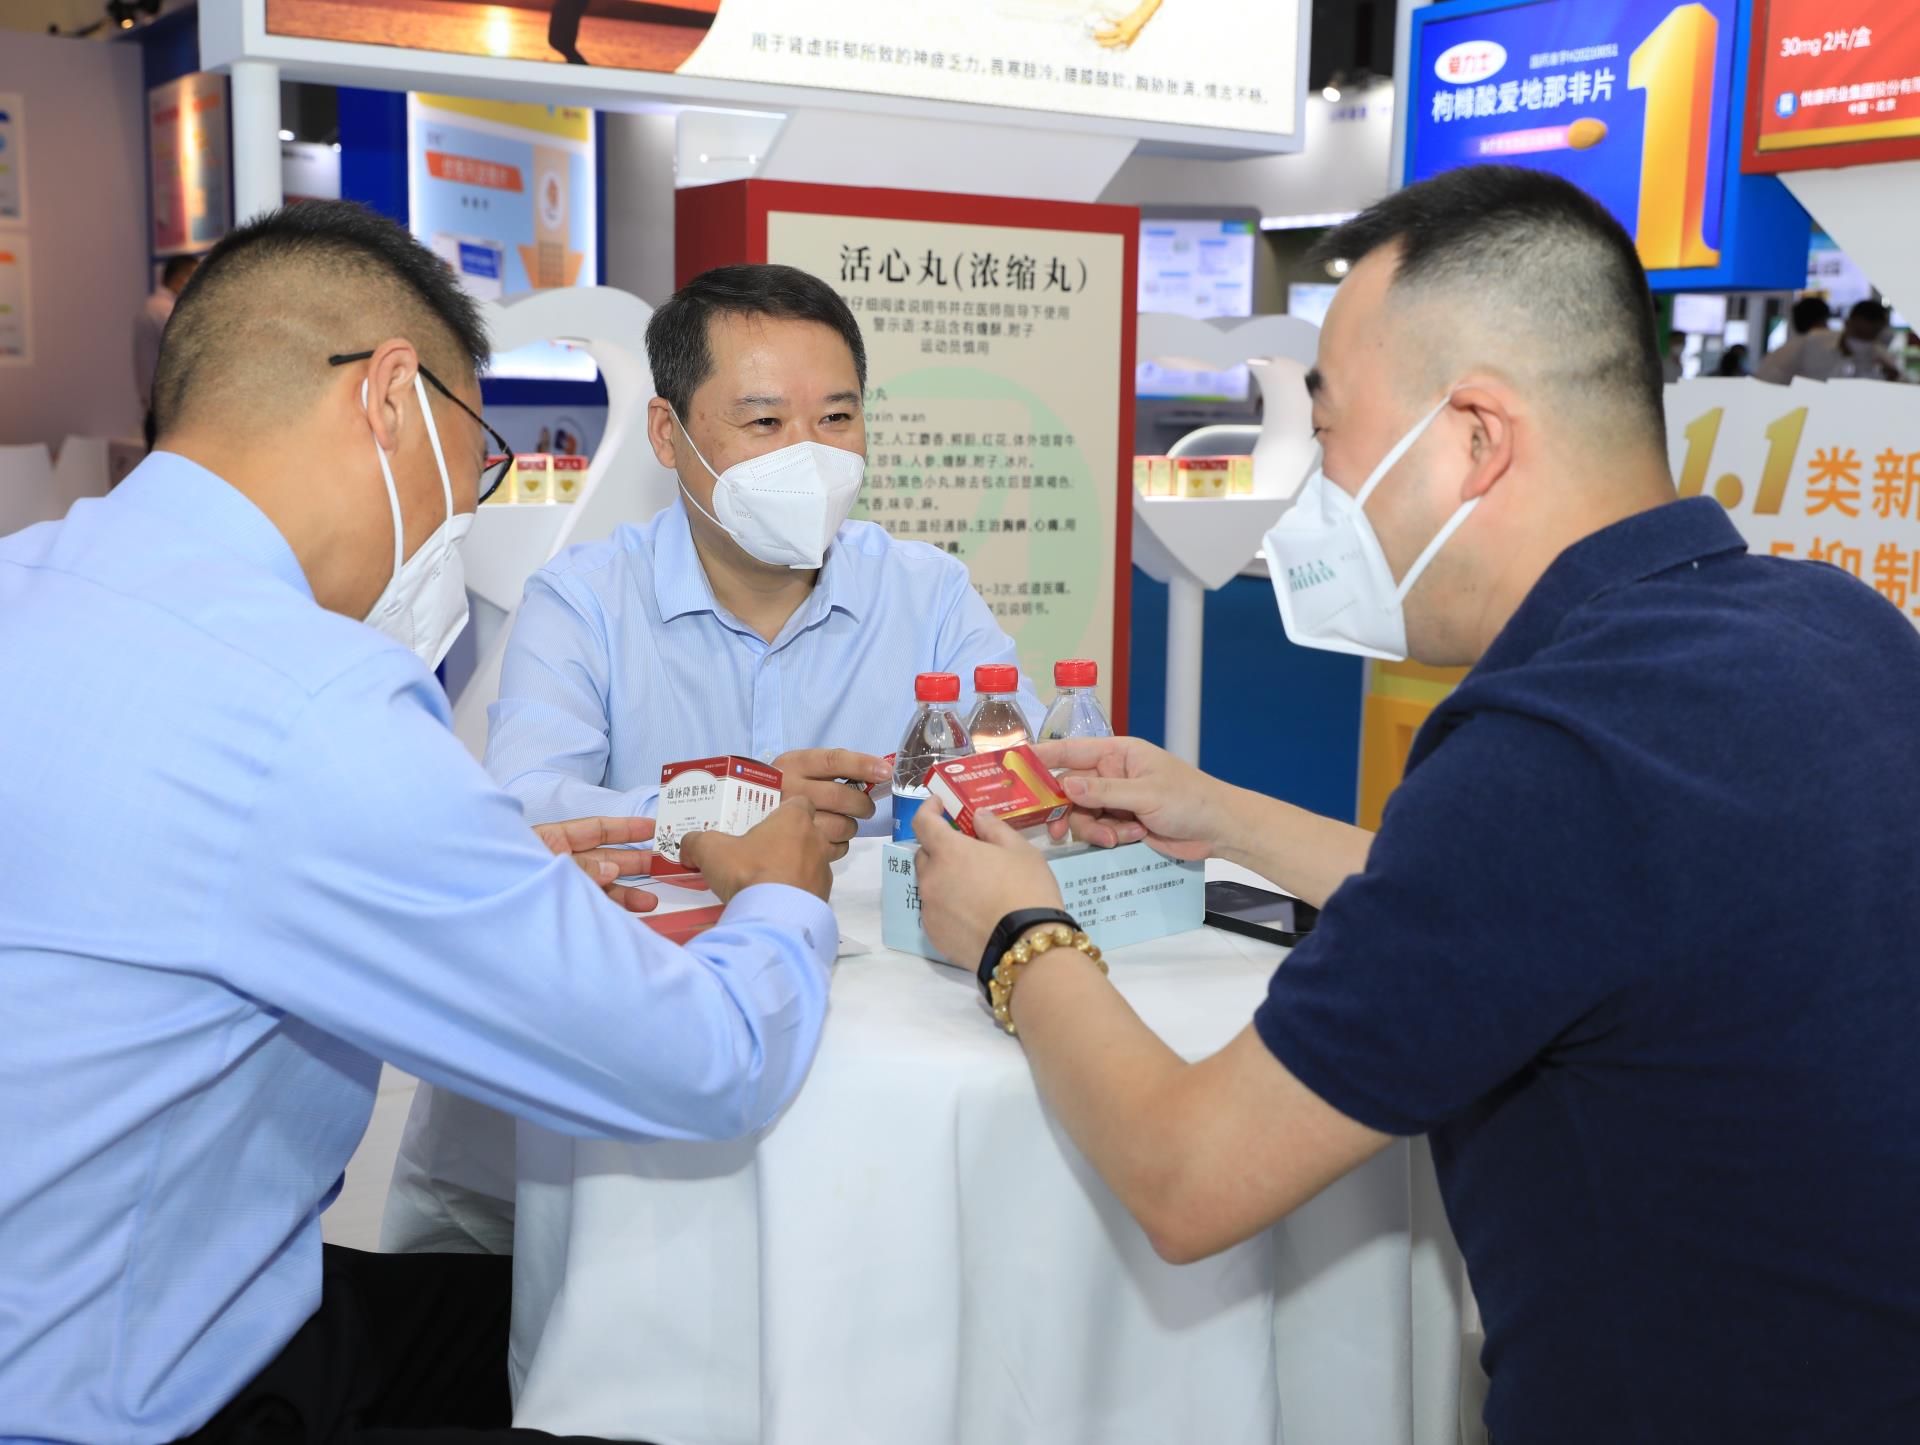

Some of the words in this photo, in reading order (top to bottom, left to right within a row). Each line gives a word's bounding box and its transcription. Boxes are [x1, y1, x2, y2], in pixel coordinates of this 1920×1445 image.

[1780, 37, 1822, 57] 30mg
[1823, 25, 1872, 51] 2片/盒
[840, 244, 1088, 293] 活心丸(浓缩丸)
